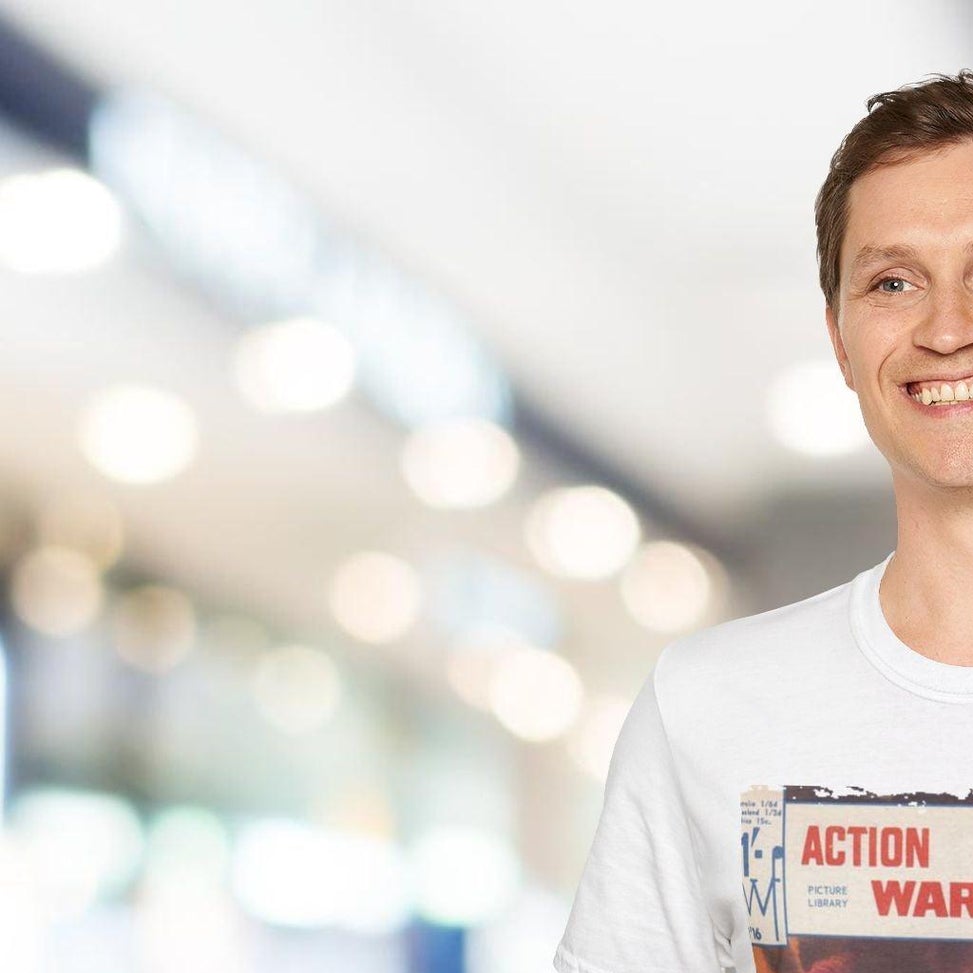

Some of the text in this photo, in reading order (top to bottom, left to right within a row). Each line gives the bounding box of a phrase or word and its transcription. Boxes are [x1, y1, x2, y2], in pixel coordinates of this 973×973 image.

[801, 825, 930, 868] ACTION
[807, 885, 848, 896] PICTURE
[807, 898, 848, 908] LIBRARY
